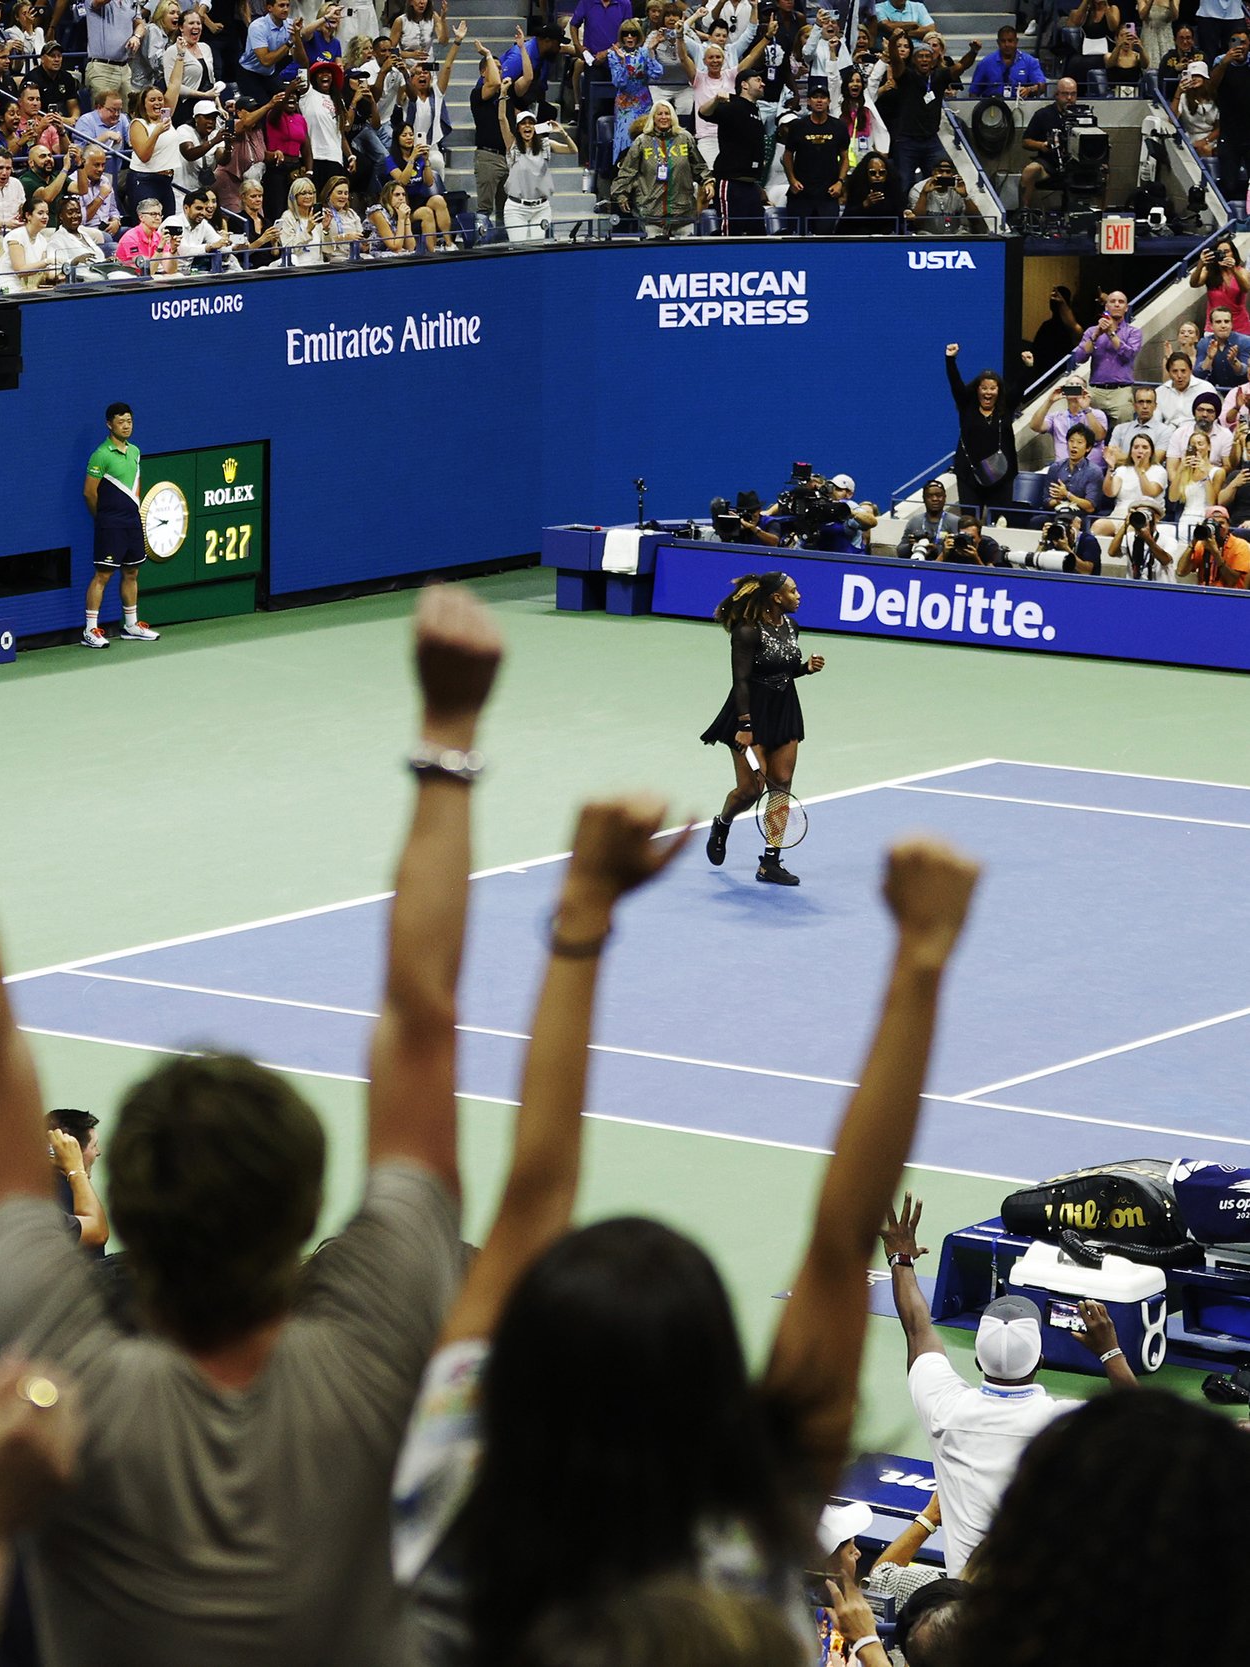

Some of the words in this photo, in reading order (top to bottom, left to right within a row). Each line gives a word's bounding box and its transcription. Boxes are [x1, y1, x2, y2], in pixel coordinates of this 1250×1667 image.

[644, 143, 689, 160] FAKE
[1106, 224, 1131, 250] EXIT
[907, 250, 977, 270] USTA
[635, 270, 807, 300] AMERICAN
[151, 293, 243, 321] USOPEN.ORG
[658, 299, 810, 328] EXPRESS
[286, 322, 394, 366] Emirates
[400, 310, 481, 353] Airline
[203, 484, 255, 507] ROLEX
[205, 524, 251, 564] 2:27
[839, 573, 1057, 642] Deloitte.
[1219, 1199, 1235, 1210] us
